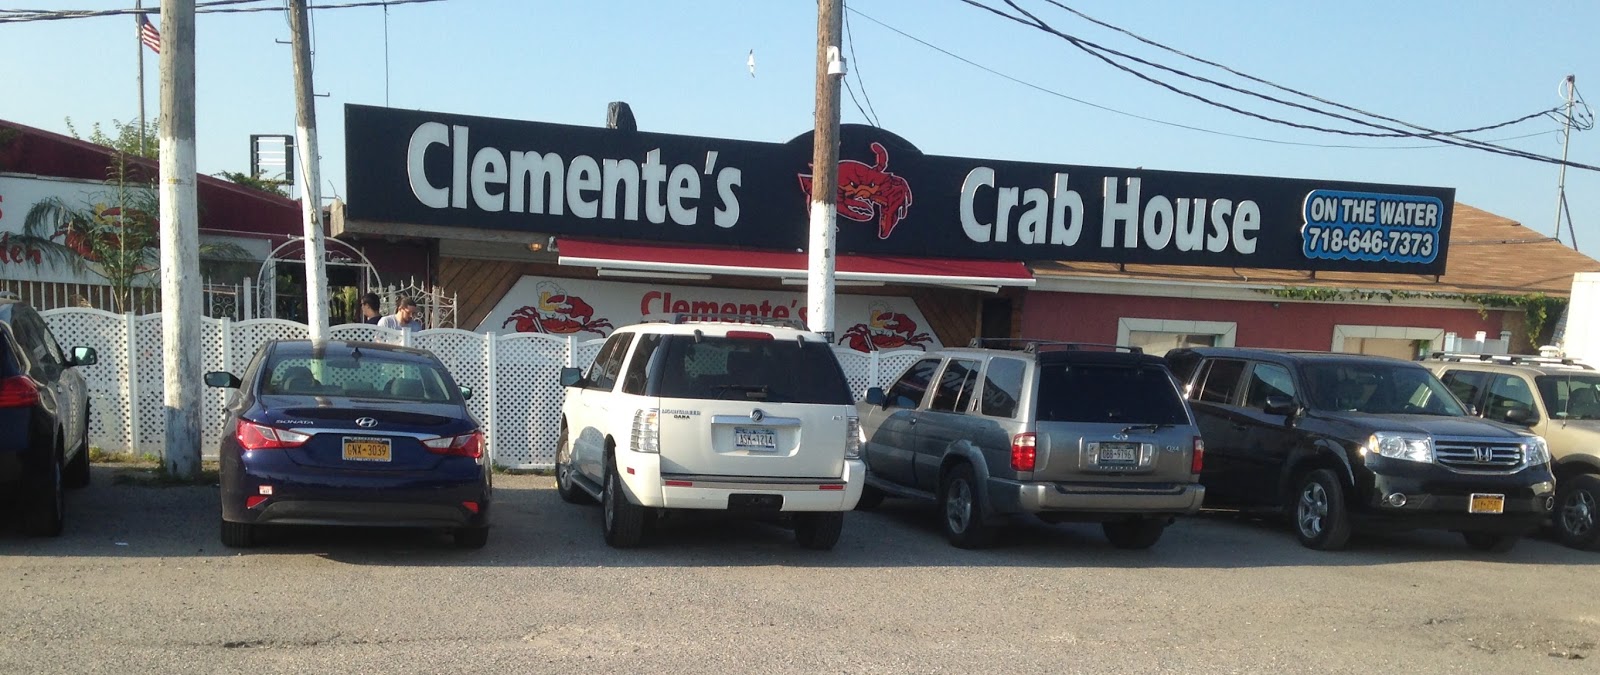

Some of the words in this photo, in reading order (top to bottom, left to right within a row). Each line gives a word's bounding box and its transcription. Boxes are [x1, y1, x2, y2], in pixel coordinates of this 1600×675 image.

[407, 121, 742, 228] Clemente's
[960, 166, 1084, 247] Crab
[1100, 176, 1261, 254] House
[1310, 196, 1338, 222] ON
[1342, 198, 1376, 223] THE
[1380, 201, 1438, 227] WATER
[1308, 227, 1433, 257] 718-646-7373
